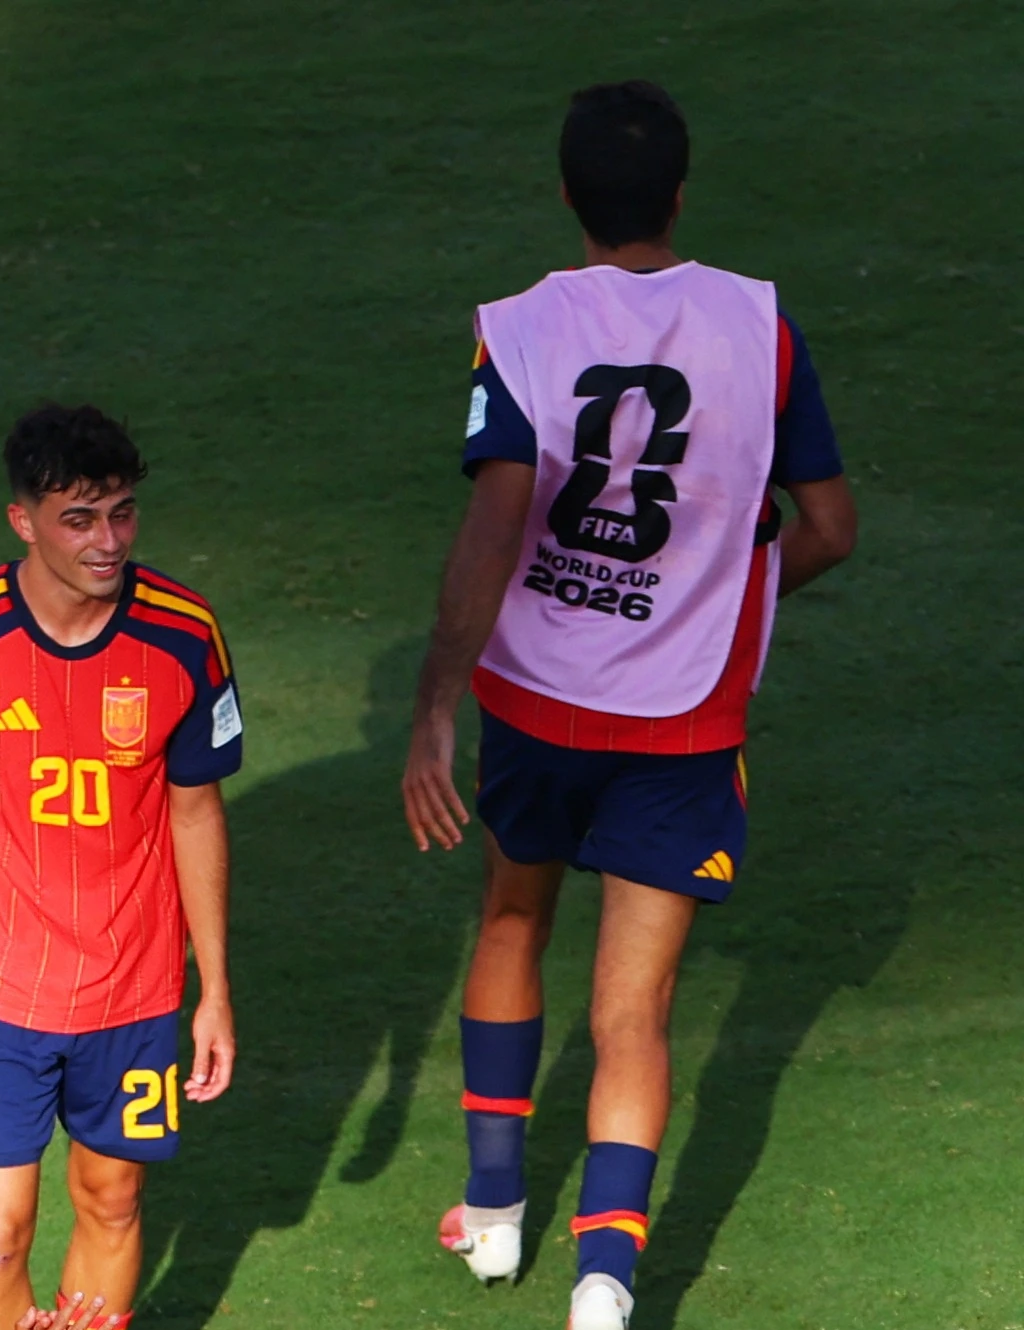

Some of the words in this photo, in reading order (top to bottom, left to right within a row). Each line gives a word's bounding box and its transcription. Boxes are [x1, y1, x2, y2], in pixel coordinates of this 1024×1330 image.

[578, 517, 637, 545] FIFA
[536, 541, 612, 582] WORLD
[615, 569, 661, 589] CUP
[523, 564, 654, 621] 2026
[30, 756, 110, 826] 20
